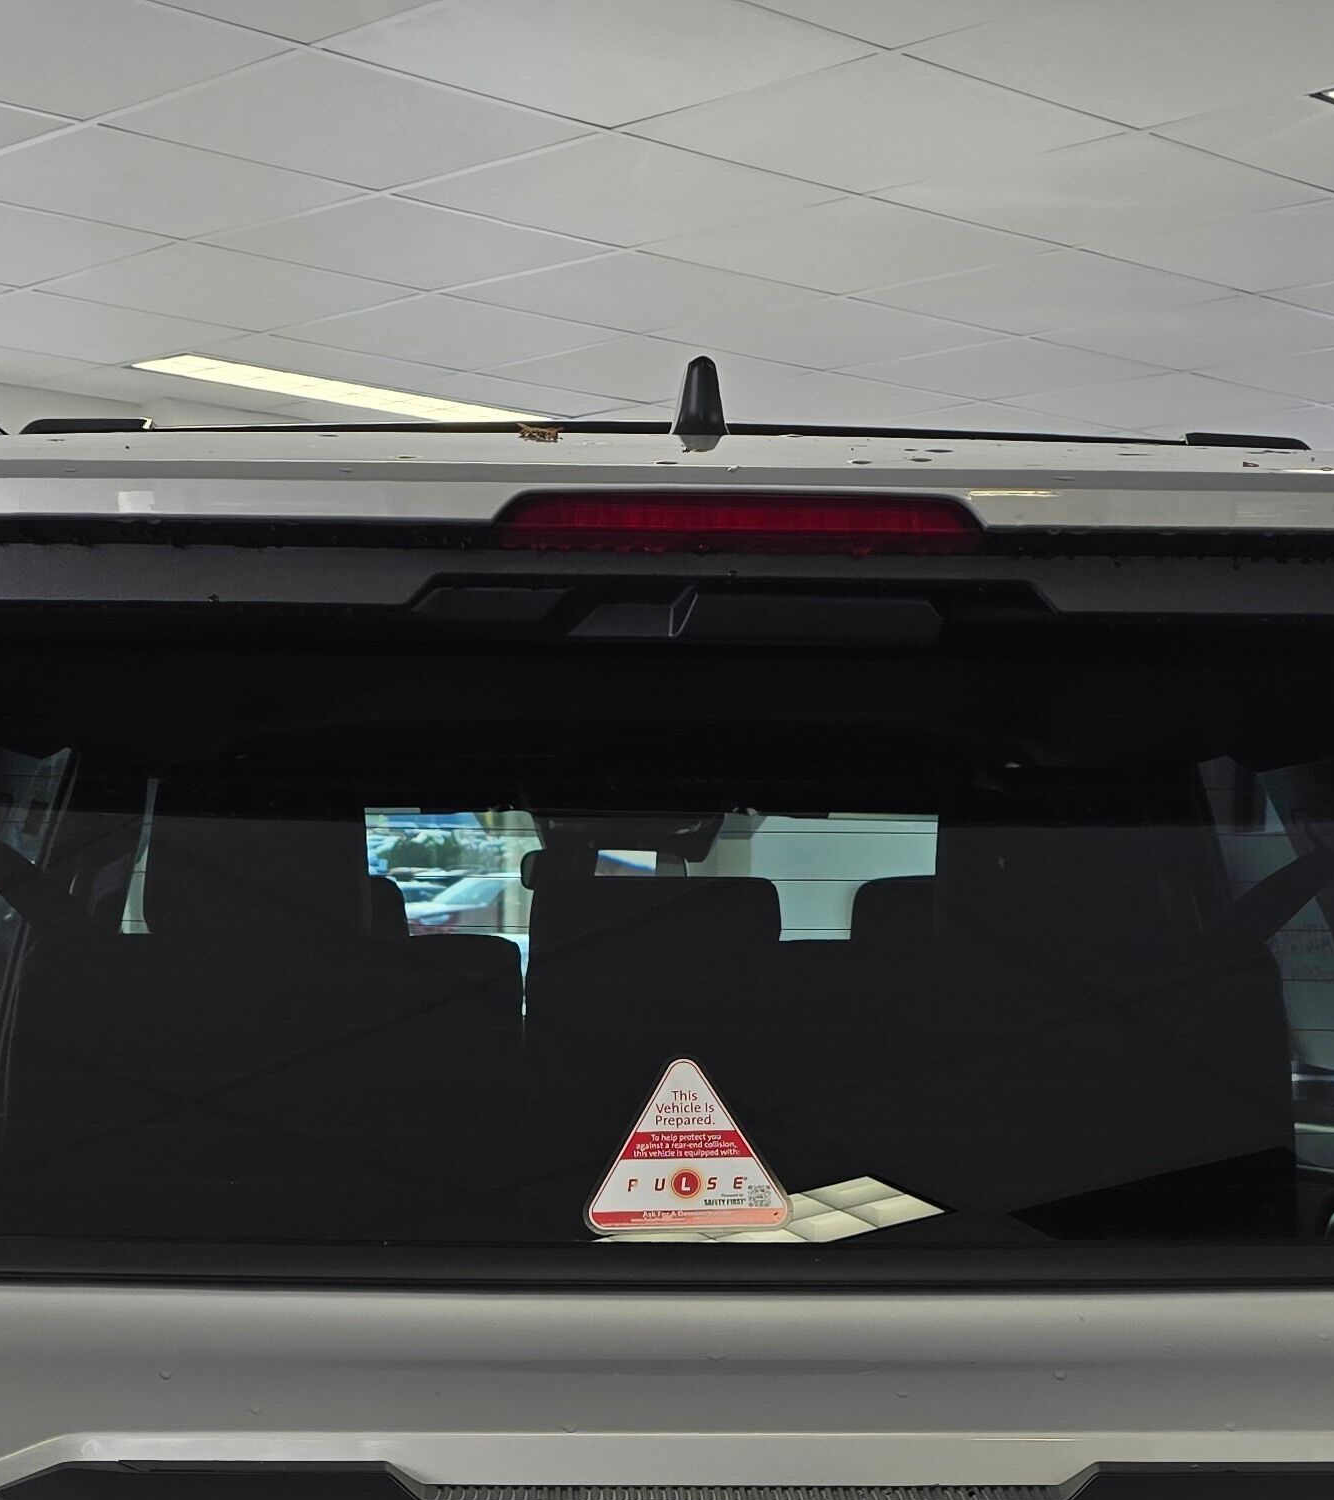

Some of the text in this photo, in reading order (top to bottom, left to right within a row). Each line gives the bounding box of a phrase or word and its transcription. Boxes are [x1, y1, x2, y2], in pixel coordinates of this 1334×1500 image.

[671, 1090, 698, 1101] This
[656, 1102, 715, 1113] Vehicle Is
[655, 1114, 715, 1128] Prepared.
[651, 1134, 722, 1142] To help protect you
[636, 1142, 664, 1152] against
[671, 1141, 703, 1149] rear-end
[633, 1150, 648, 1158] this
[649, 1149, 676, 1157] vehicle
[677, 1149, 683, 1157] is
[684, 1149, 719, 1158] equipped
